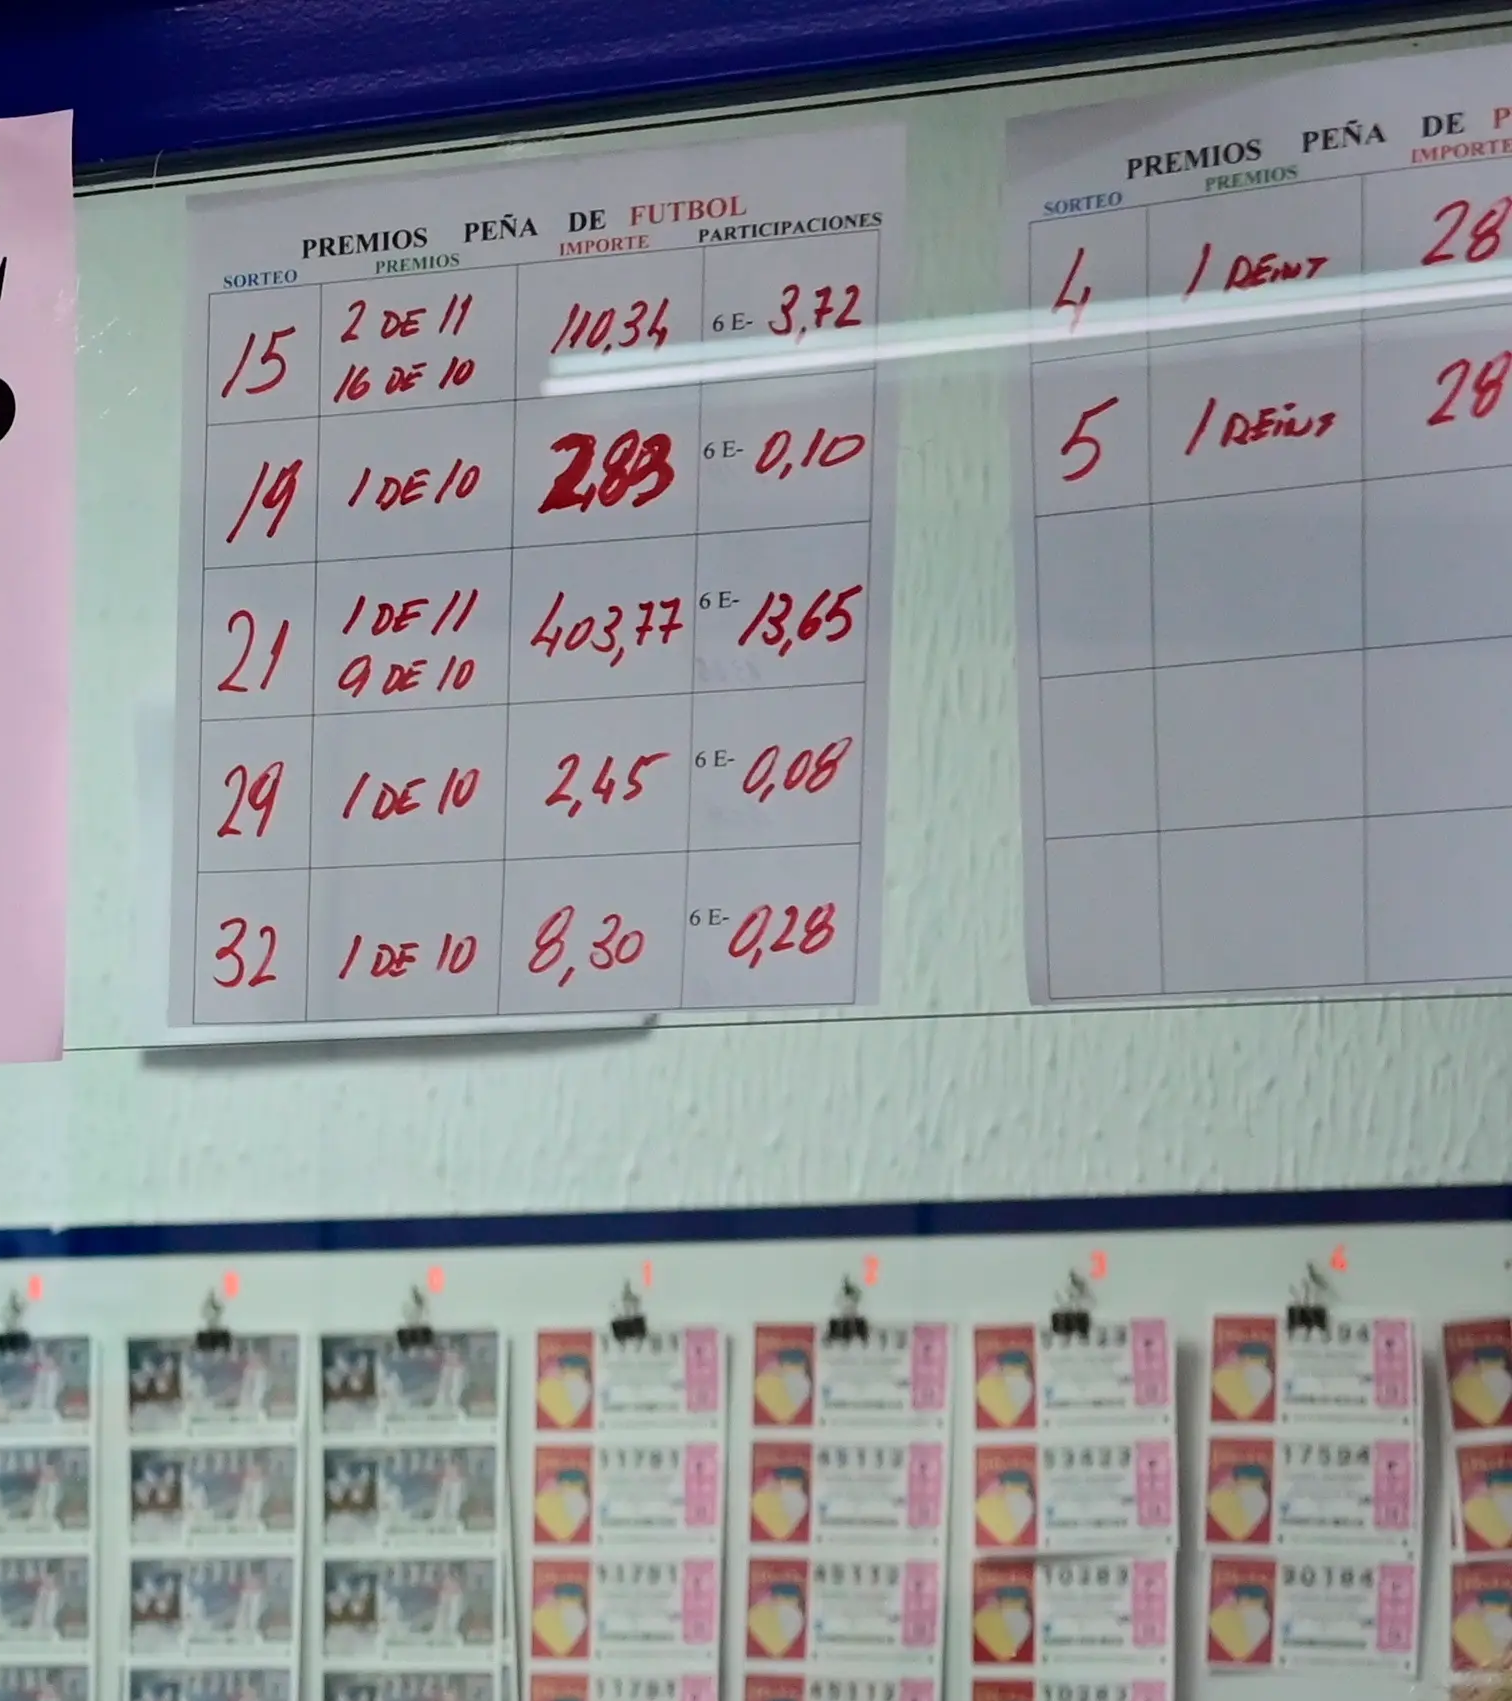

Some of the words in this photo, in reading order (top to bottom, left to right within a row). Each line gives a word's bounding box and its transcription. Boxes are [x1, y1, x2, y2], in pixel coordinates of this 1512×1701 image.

[1126, 138, 1262, 180] PREMIOS
[1301, 120, 1387, 153] PEÑA
[1422, 111, 1464, 138] DE
[1044, 191, 1122, 217] SORTEO
[1205, 165, 1297, 193] PREMIOS
[301, 226, 429, 261] PREMIOS
[464, 213, 538, 245] PEÑA
[569, 208, 607, 233] DE
[629, 195, 747, 228] FUTBOL
[559, 233, 650, 258] IMPORTE
[698, 212, 883, 244] PARTICIPACIONES
[223, 268, 298, 290] SORTEO
[375, 252, 460, 275] PREMIOS
[768, 283, 862, 344] 3,72
[222, 326, 296, 399] 15
[1061, 397, 1119, 481] 5
[218, 608, 289, 693] 21
[531, 591, 684, 667] 403,77
[739, 585, 864, 657] 13,65
[217, 761, 284, 838] 29
[546, 751, 671, 817] 2,45
[213, 917, 277, 989] 32
